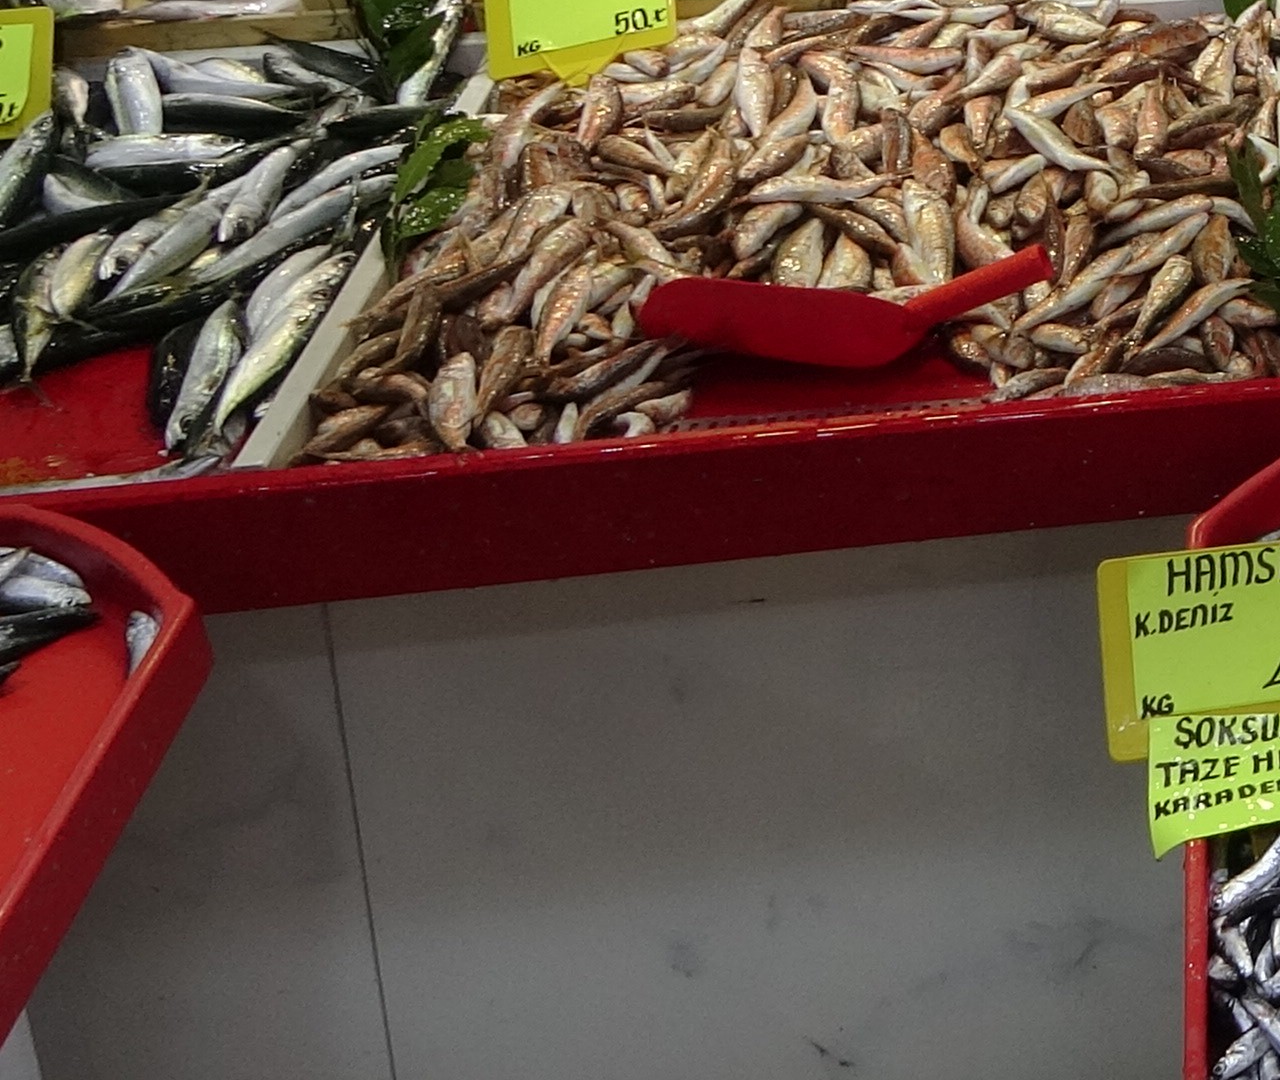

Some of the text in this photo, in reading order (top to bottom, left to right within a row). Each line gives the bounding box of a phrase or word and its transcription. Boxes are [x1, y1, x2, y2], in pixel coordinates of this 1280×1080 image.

[517, 40, 541, 56] KG
[1141, 693, 1175, 720] KG
[1155, 756, 1240, 788] TAZE
